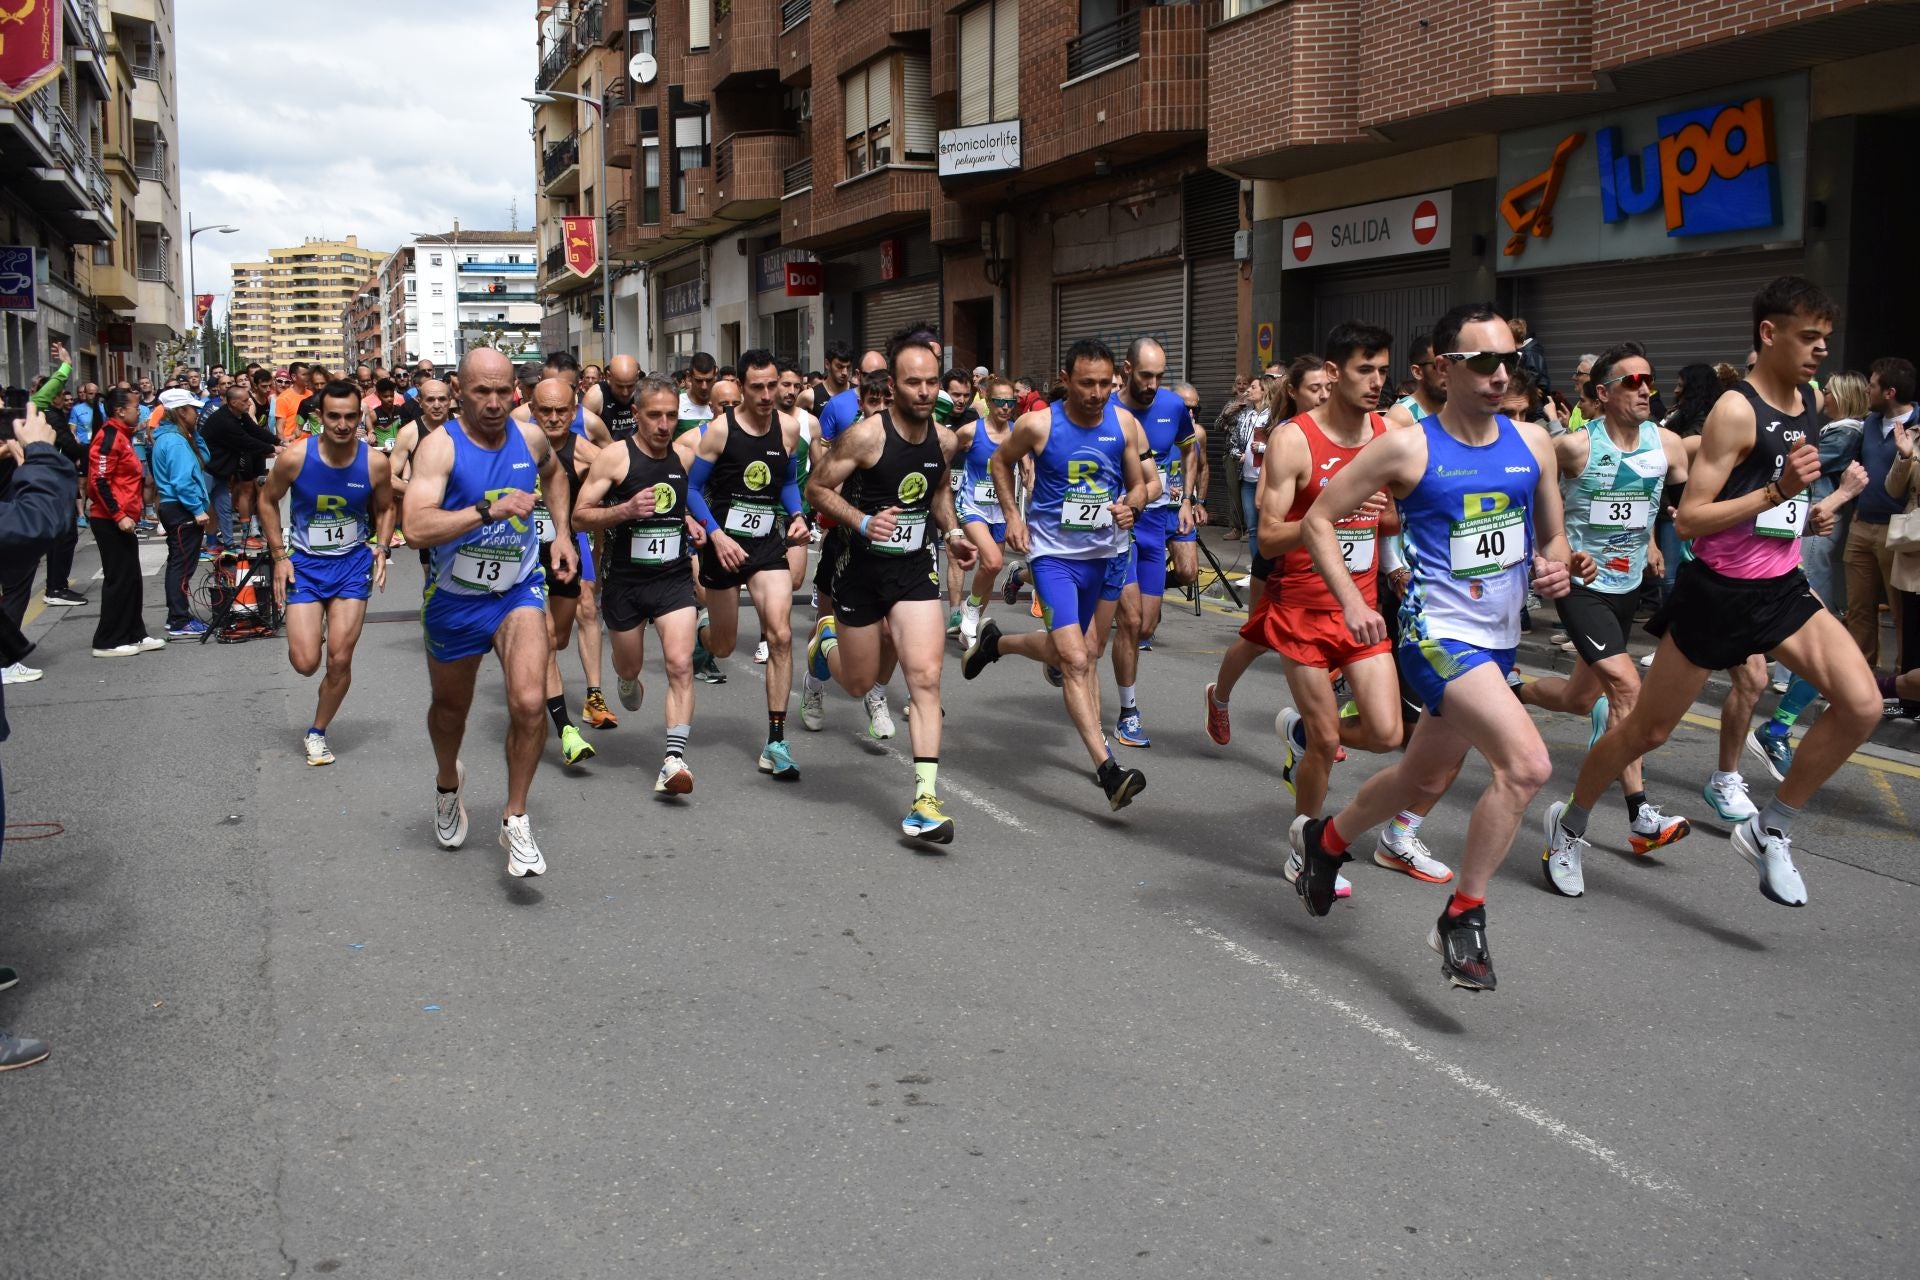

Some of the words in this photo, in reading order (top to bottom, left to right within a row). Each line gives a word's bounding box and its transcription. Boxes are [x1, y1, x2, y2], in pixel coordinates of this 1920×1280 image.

[940, 131, 1017, 155] @monicolorlife
[1596, 97, 1776, 232] lupa
[1331, 217, 1391, 248] SALIDA
[1068, 460, 1108, 494] R
[317, 494, 348, 519] R
[1079, 504, 1101, 521] 27
[1608, 502, 1632, 521] 33
[1785, 501, 1797, 524] 3
[482, 523, 506, 535] CLUB
[741, 513, 761, 529] 26
[1466, 518, 1492, 527] CARRERA
[1492, 512, 1516, 521] POPULAR
[324, 526, 344, 541] 14
[891, 525, 912, 543] 34
[647, 538, 666, 554] 41
[1342, 542, 1355, 561] 2
[1475, 531, 1505, 558] 40
[476, 560, 501, 581] 13
